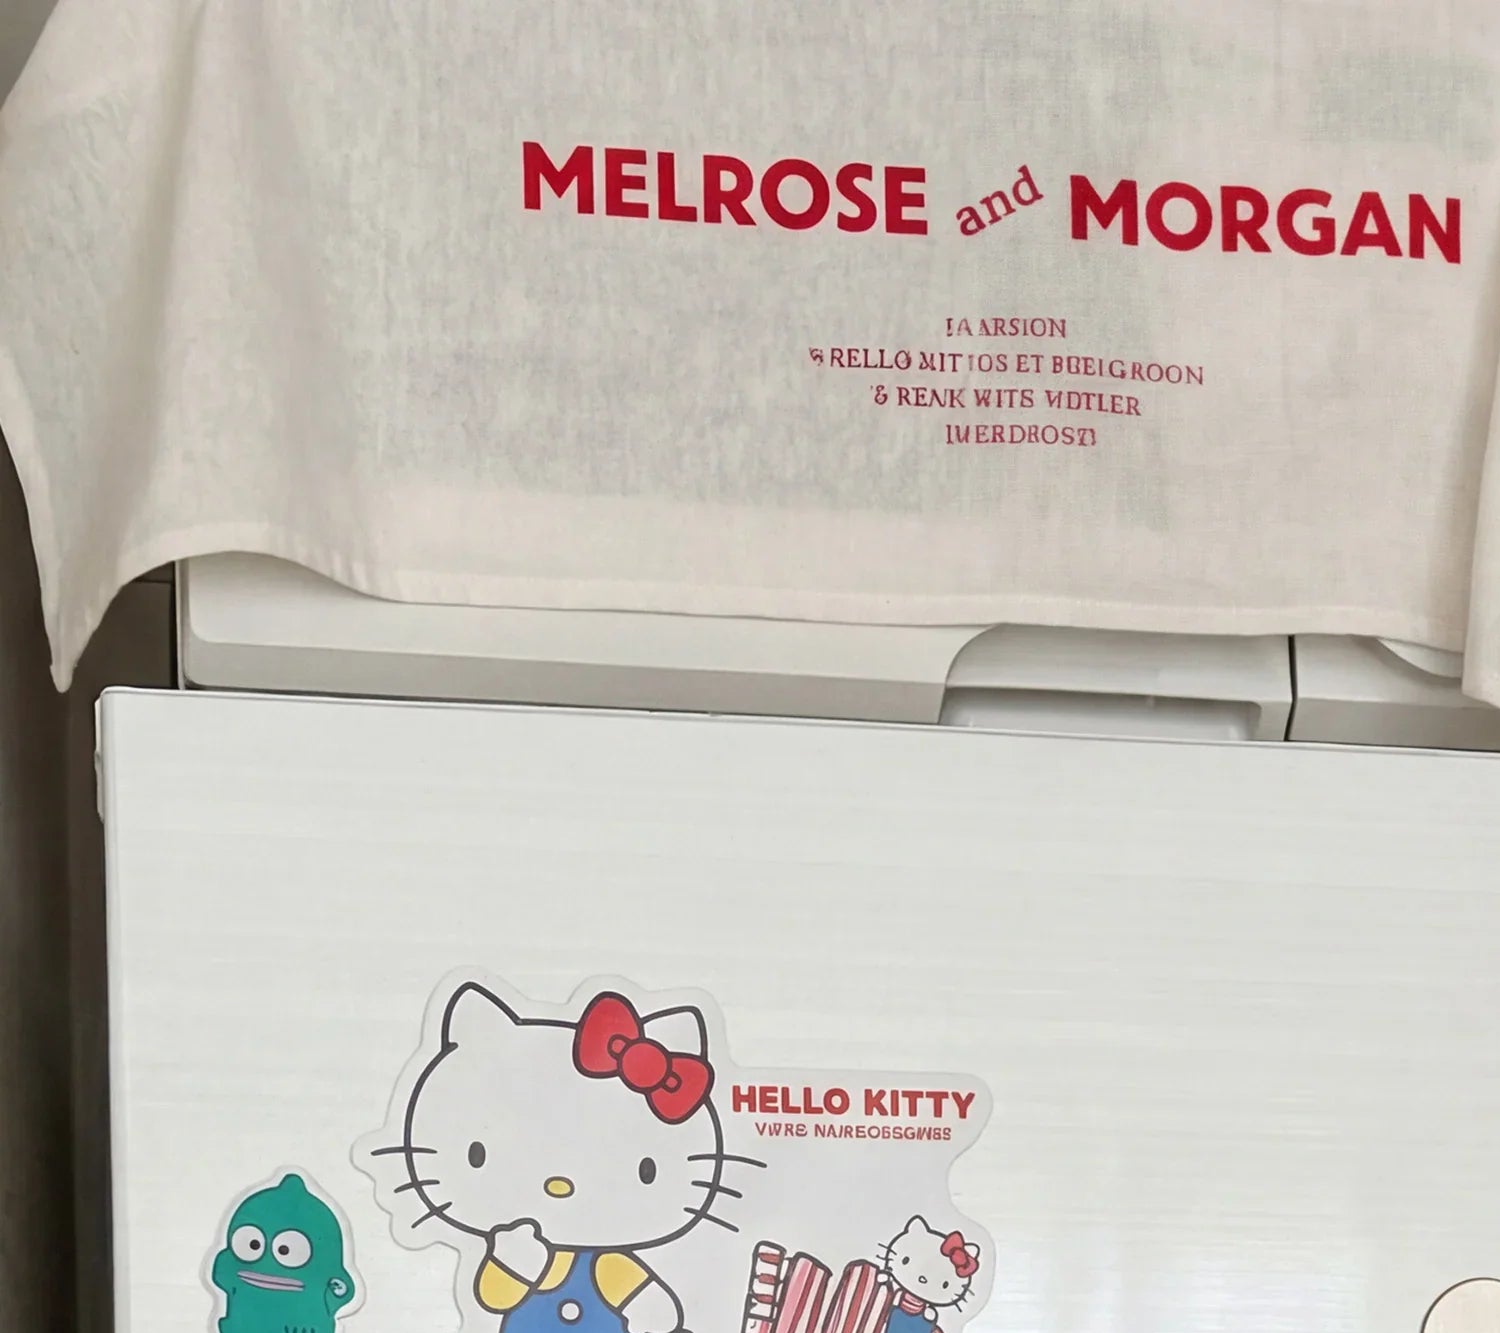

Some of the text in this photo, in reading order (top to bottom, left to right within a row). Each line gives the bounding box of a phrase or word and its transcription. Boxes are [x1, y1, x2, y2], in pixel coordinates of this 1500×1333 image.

[521, 141, 1462, 265] MELROSE and MORGAN
[732, 1084, 976, 1120] HELLO KITTY
